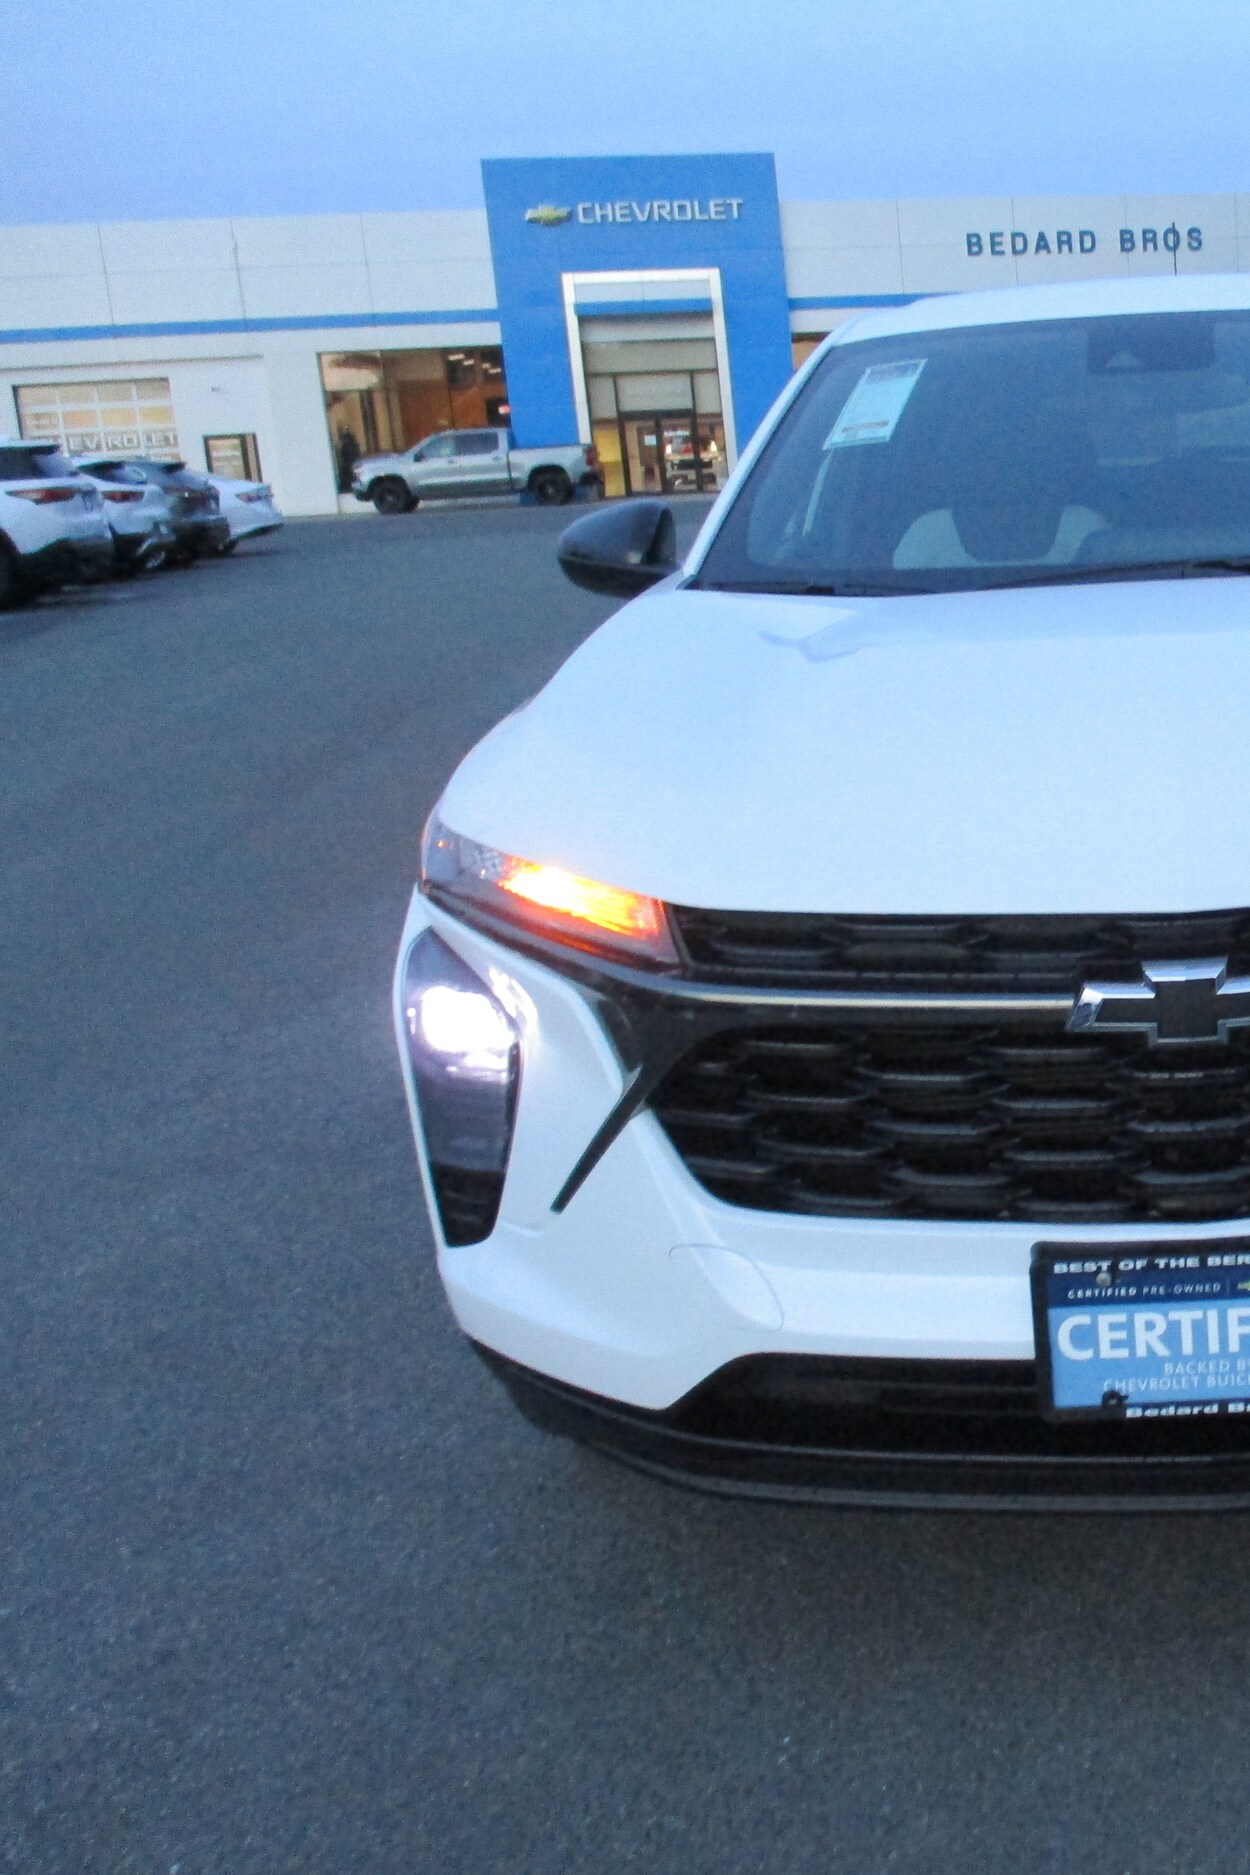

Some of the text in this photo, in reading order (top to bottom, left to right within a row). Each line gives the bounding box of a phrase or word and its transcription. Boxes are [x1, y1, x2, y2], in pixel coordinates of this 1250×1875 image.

[576, 199, 744, 224] CHEVROLET
[966, 227, 1204, 257] BEDARD BROS
[1053, 1260, 1112, 1274] BEST
[1119, 1258, 1148, 1271] OF
[1154, 1255, 1200, 1269] THE
[1067, 1281, 1221, 1299] CERTIFIED PRE-OWNED
[1164, 1358, 1230, 1376] BACKED
[1103, 1375, 1199, 1392] CHEVROLET
[1126, 1403, 1219, 1418] Bedard
